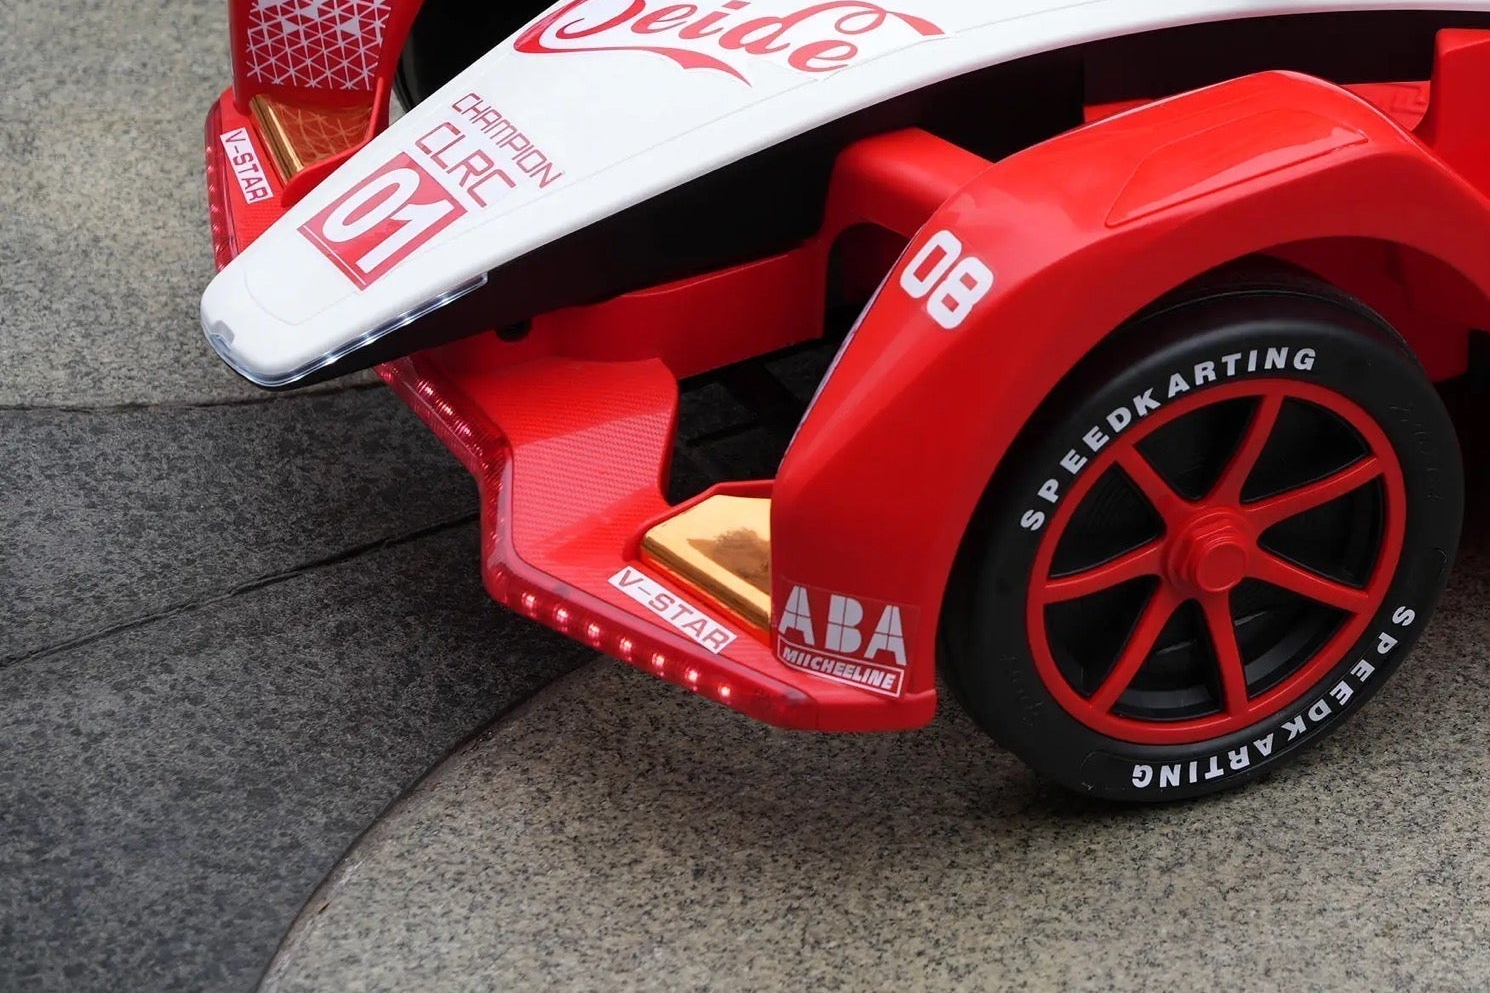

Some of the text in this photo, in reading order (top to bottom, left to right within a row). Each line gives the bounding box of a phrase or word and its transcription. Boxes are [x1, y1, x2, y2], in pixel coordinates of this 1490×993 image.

[224, 129, 269, 202] V-STAR
[415, 121, 517, 208] CLRC
[451, 92, 563, 189] CHAMPION
[321, 166, 456, 275] 01
[899, 229, 995, 329] 08
[1020, 346, 1318, 531] SPEEDKARTING
[619, 568, 732, 653] V-STAR
[778, 585, 907, 667] ABA
[1131, 605, 1416, 790] SPEEDKARTING
